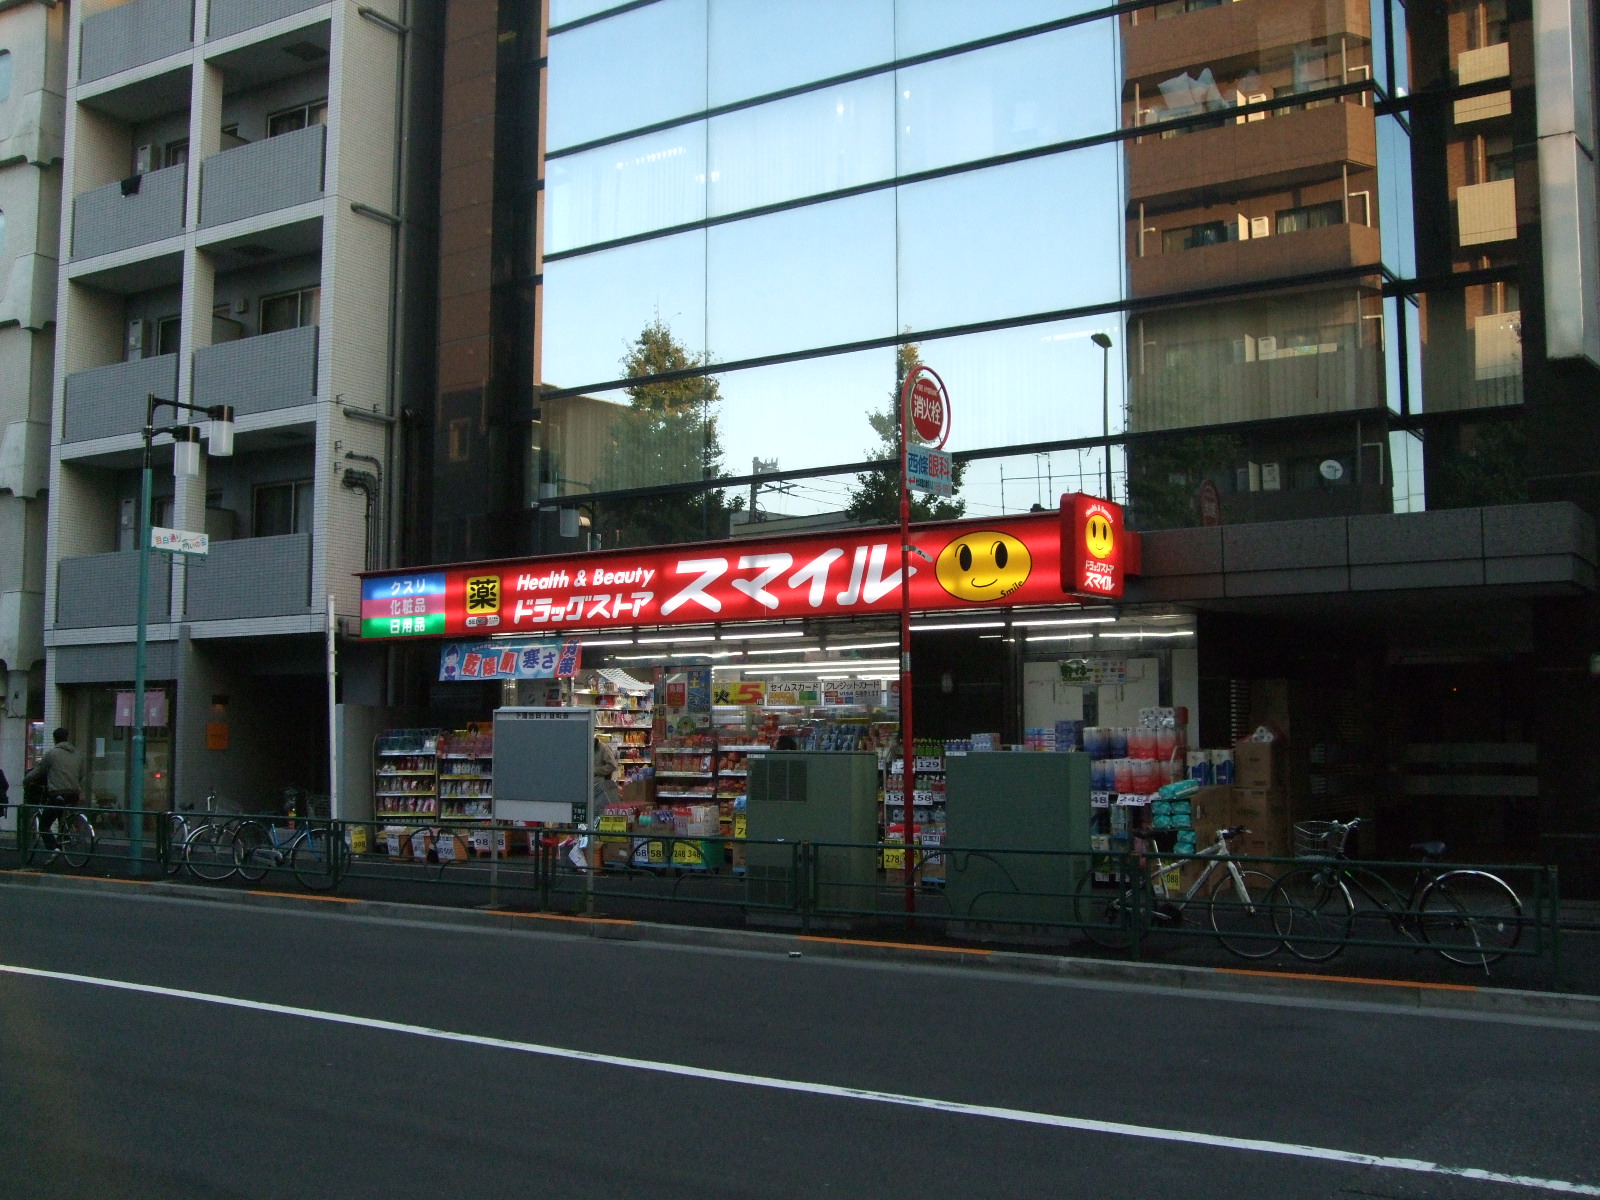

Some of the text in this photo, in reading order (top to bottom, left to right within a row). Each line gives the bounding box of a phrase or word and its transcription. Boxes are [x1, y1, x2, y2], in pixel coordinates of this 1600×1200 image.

[914, 393, 941, 425] 消火栓
[1085, 560, 1115, 574] ドラッグストア
[391, 579, 426, 596] クスリ
[516, 567, 655, 591] Health & Beauty
[660, 543, 918, 616] スマイル
[1083, 572, 1116, 592] スマイル
[469, 579, 497, 609] 薬
[1000, 580, 1024, 599] Smile
[390, 598, 426, 615] 化粧品
[514, 591, 654, 625] ドラッグストア
[390, 617, 426, 634] 日用品
[770, 683, 818, 692] セイムスカード
[826, 681, 880, 690] クレジットカード
[475, 838, 489, 846] 98
[885, 855, 900, 863] 278
